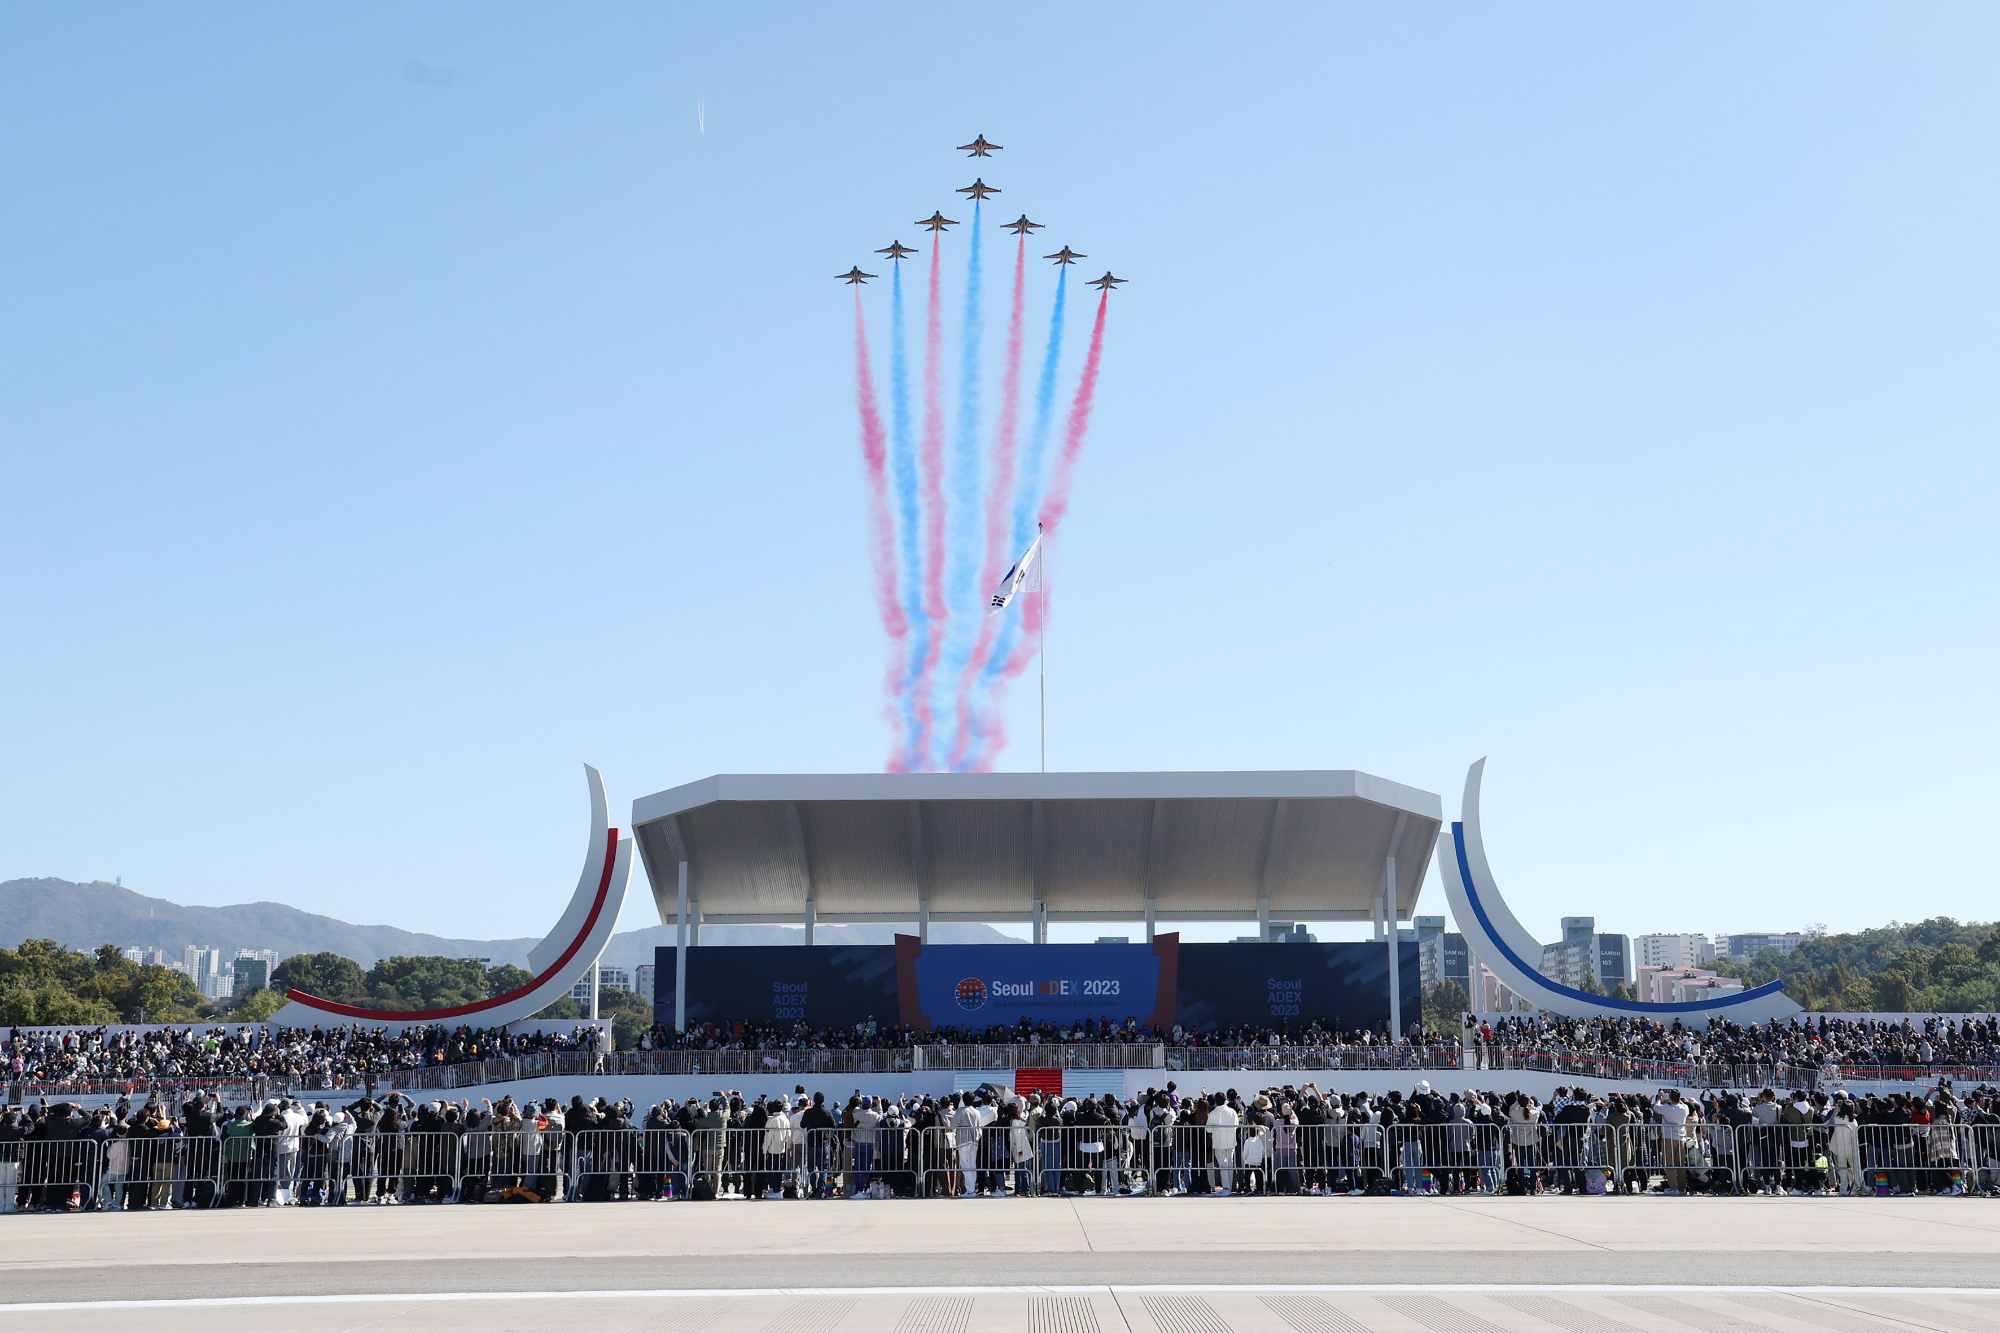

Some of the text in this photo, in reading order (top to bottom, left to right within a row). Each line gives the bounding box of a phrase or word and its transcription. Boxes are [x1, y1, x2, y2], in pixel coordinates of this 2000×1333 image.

[773, 981, 808, 993] Seoul
[992, 980, 1120, 996] Seoul ADEX 2023
[1267, 978, 1302, 990] Seoul
[772, 994, 808, 1006] ADEX
[1267, 991, 1302, 1003] ADEX
[775, 1007, 804, 1019] 2023
[1270, 1004, 1300, 1016] 2023
